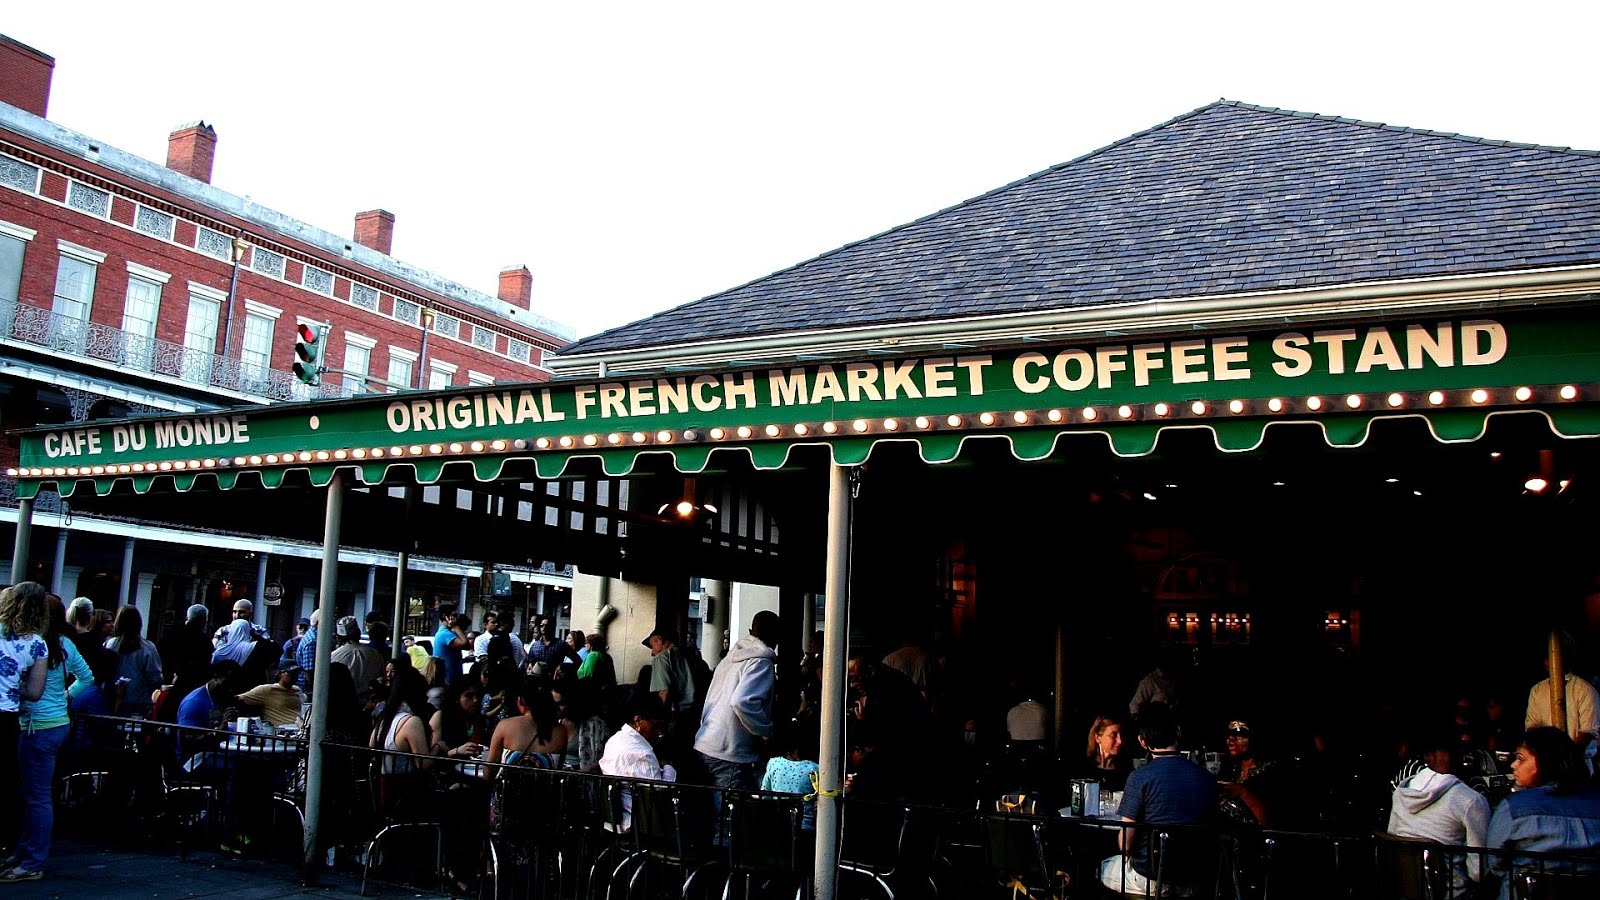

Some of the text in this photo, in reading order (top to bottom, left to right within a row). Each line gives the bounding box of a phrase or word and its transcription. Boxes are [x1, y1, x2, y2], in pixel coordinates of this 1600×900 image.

[387, 320, 1507, 433] ORIGINAL FRENCH MARKET COFFEE STAND
[45, 416, 249, 458] CAFE DU MONDE
